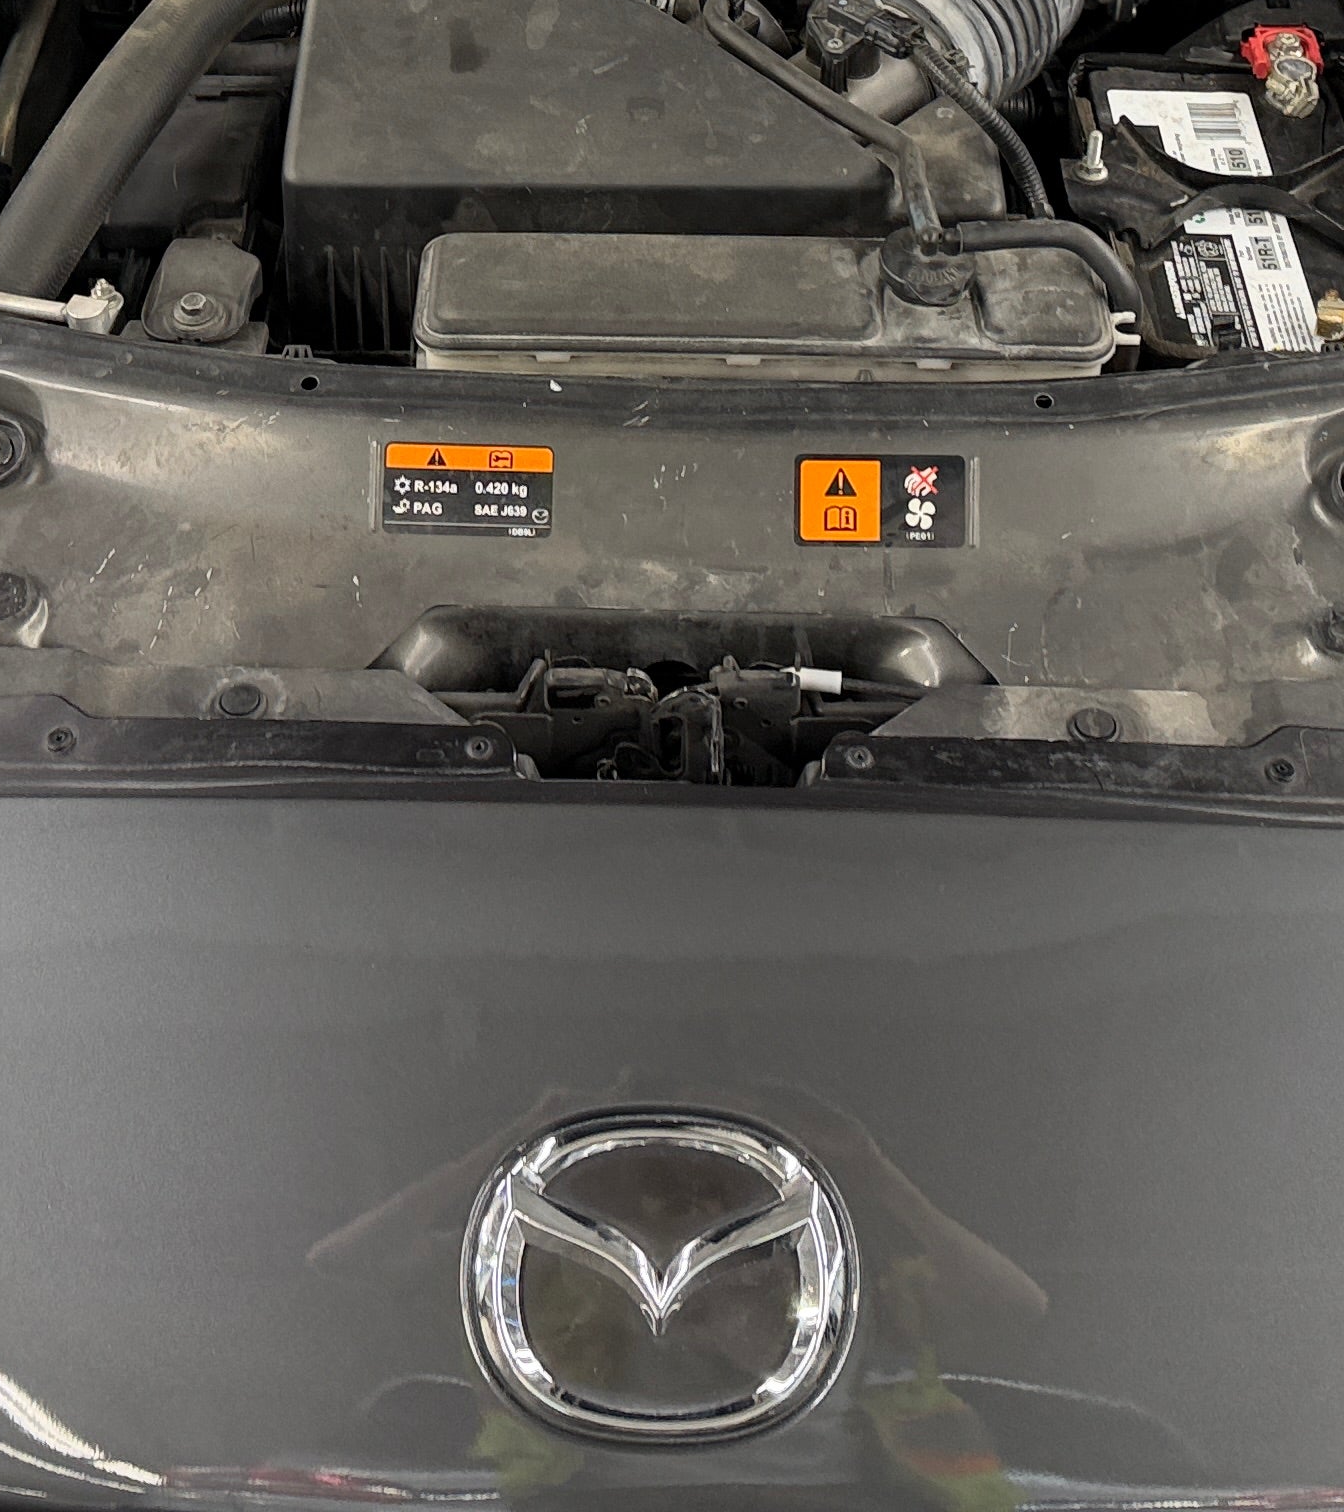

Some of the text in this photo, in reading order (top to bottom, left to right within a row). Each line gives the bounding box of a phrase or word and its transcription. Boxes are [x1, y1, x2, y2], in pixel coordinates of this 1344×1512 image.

[1229, 149, 1246, 170] 510
[1249, 210, 1264, 225] 51
[1257, 236, 1278, 271] 51R-T
[413, 480, 528, 498] R-134a 0.420 kg
[413, 502, 528, 517] PAG SAE J639
